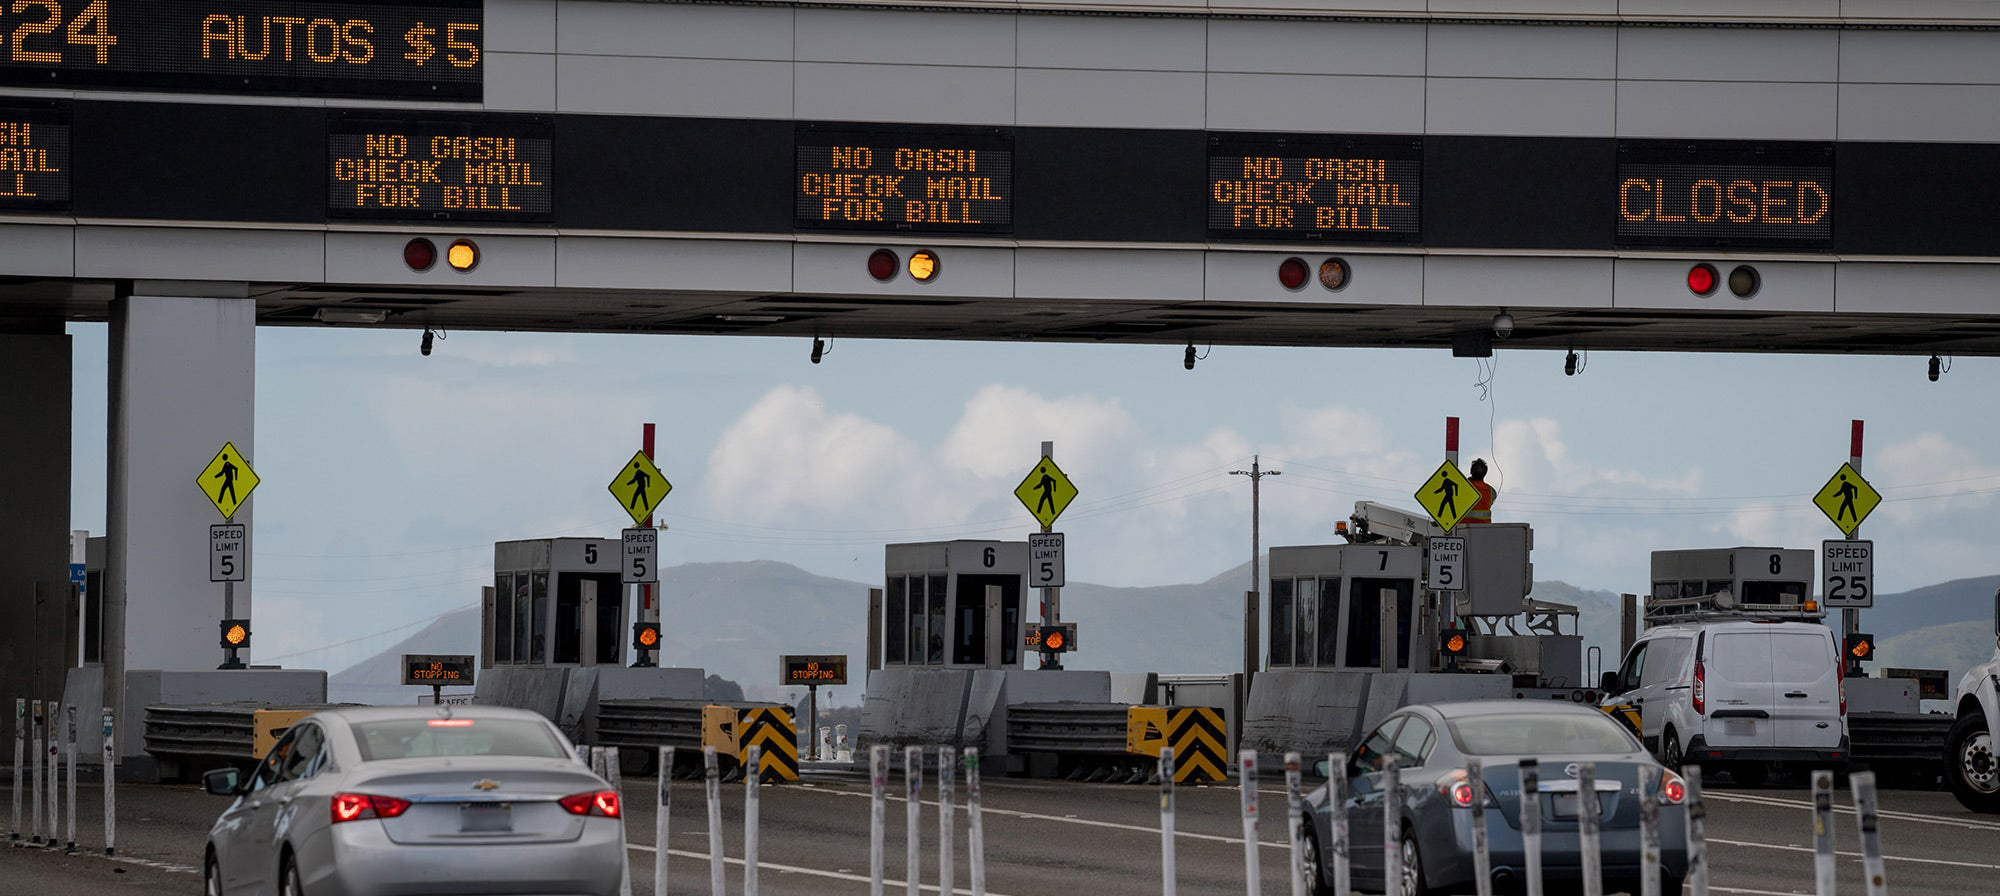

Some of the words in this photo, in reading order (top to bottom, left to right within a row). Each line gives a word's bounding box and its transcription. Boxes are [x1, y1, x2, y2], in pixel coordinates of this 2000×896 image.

[203, 14, 374, 64] AUTOS
[404, 21, 479, 67] $5
[366, 134, 407, 157] NO
[431, 136, 515, 160] CASH
[833, 146, 872, 169] NO
[895, 148, 976, 172] CASH
[1243, 156, 1283, 179] NO
[1305, 158, 1385, 181] CASH
[335, 158, 441, 183] CHECK
[465, 162, 543, 186] MAIL
[803, 173, 904, 198] CHECK
[927, 176, 1002, 200] MAIL
[1214, 180, 1314, 204] CHECK
[1337, 183, 1411, 206] MAIL
[357, 184, 420, 208] FOR
[443, 186, 521, 210] BILL
[1621, 178, 1828, 224] CLOSED
[823, 198, 884, 221] FOR
[906, 200, 981, 224] BILL
[1234, 205, 1294, 228] FOR
[1316, 206, 1390, 230] BILL
[213, 530, 242, 539] SPEED
[625, 534, 655, 543] SPEED
[1032, 539, 1061, 548] SPEED
[216, 542, 239, 551] LIMIT
[585, 543, 598, 565] 5
[628, 546, 651, 554] LIMIT
[1035, 550, 1058, 559] LIMIT
[1432, 542, 1462, 551] SPEED
[1828, 548, 1869, 559] SPEED
[221, 555, 234, 576] 5
[983, 547, 996, 568] 6
[1378, 551, 1388, 571] 7
[1434, 554, 1459, 562] LIMIT
[1769, 553, 1782, 575] 8
[1832, 562, 1864, 572] LIMIT
[633, 558, 646, 578] 5
[1040, 562, 1054, 581] 5
[1439, 565, 1453, 585] 5
[1828, 575, 1868, 601] 25
[413, 670, 460, 679] STOPPING
[430, 661, 443, 671] NO
[792, 670, 834, 679] STOPPING
[807, 662, 818, 670] NO
